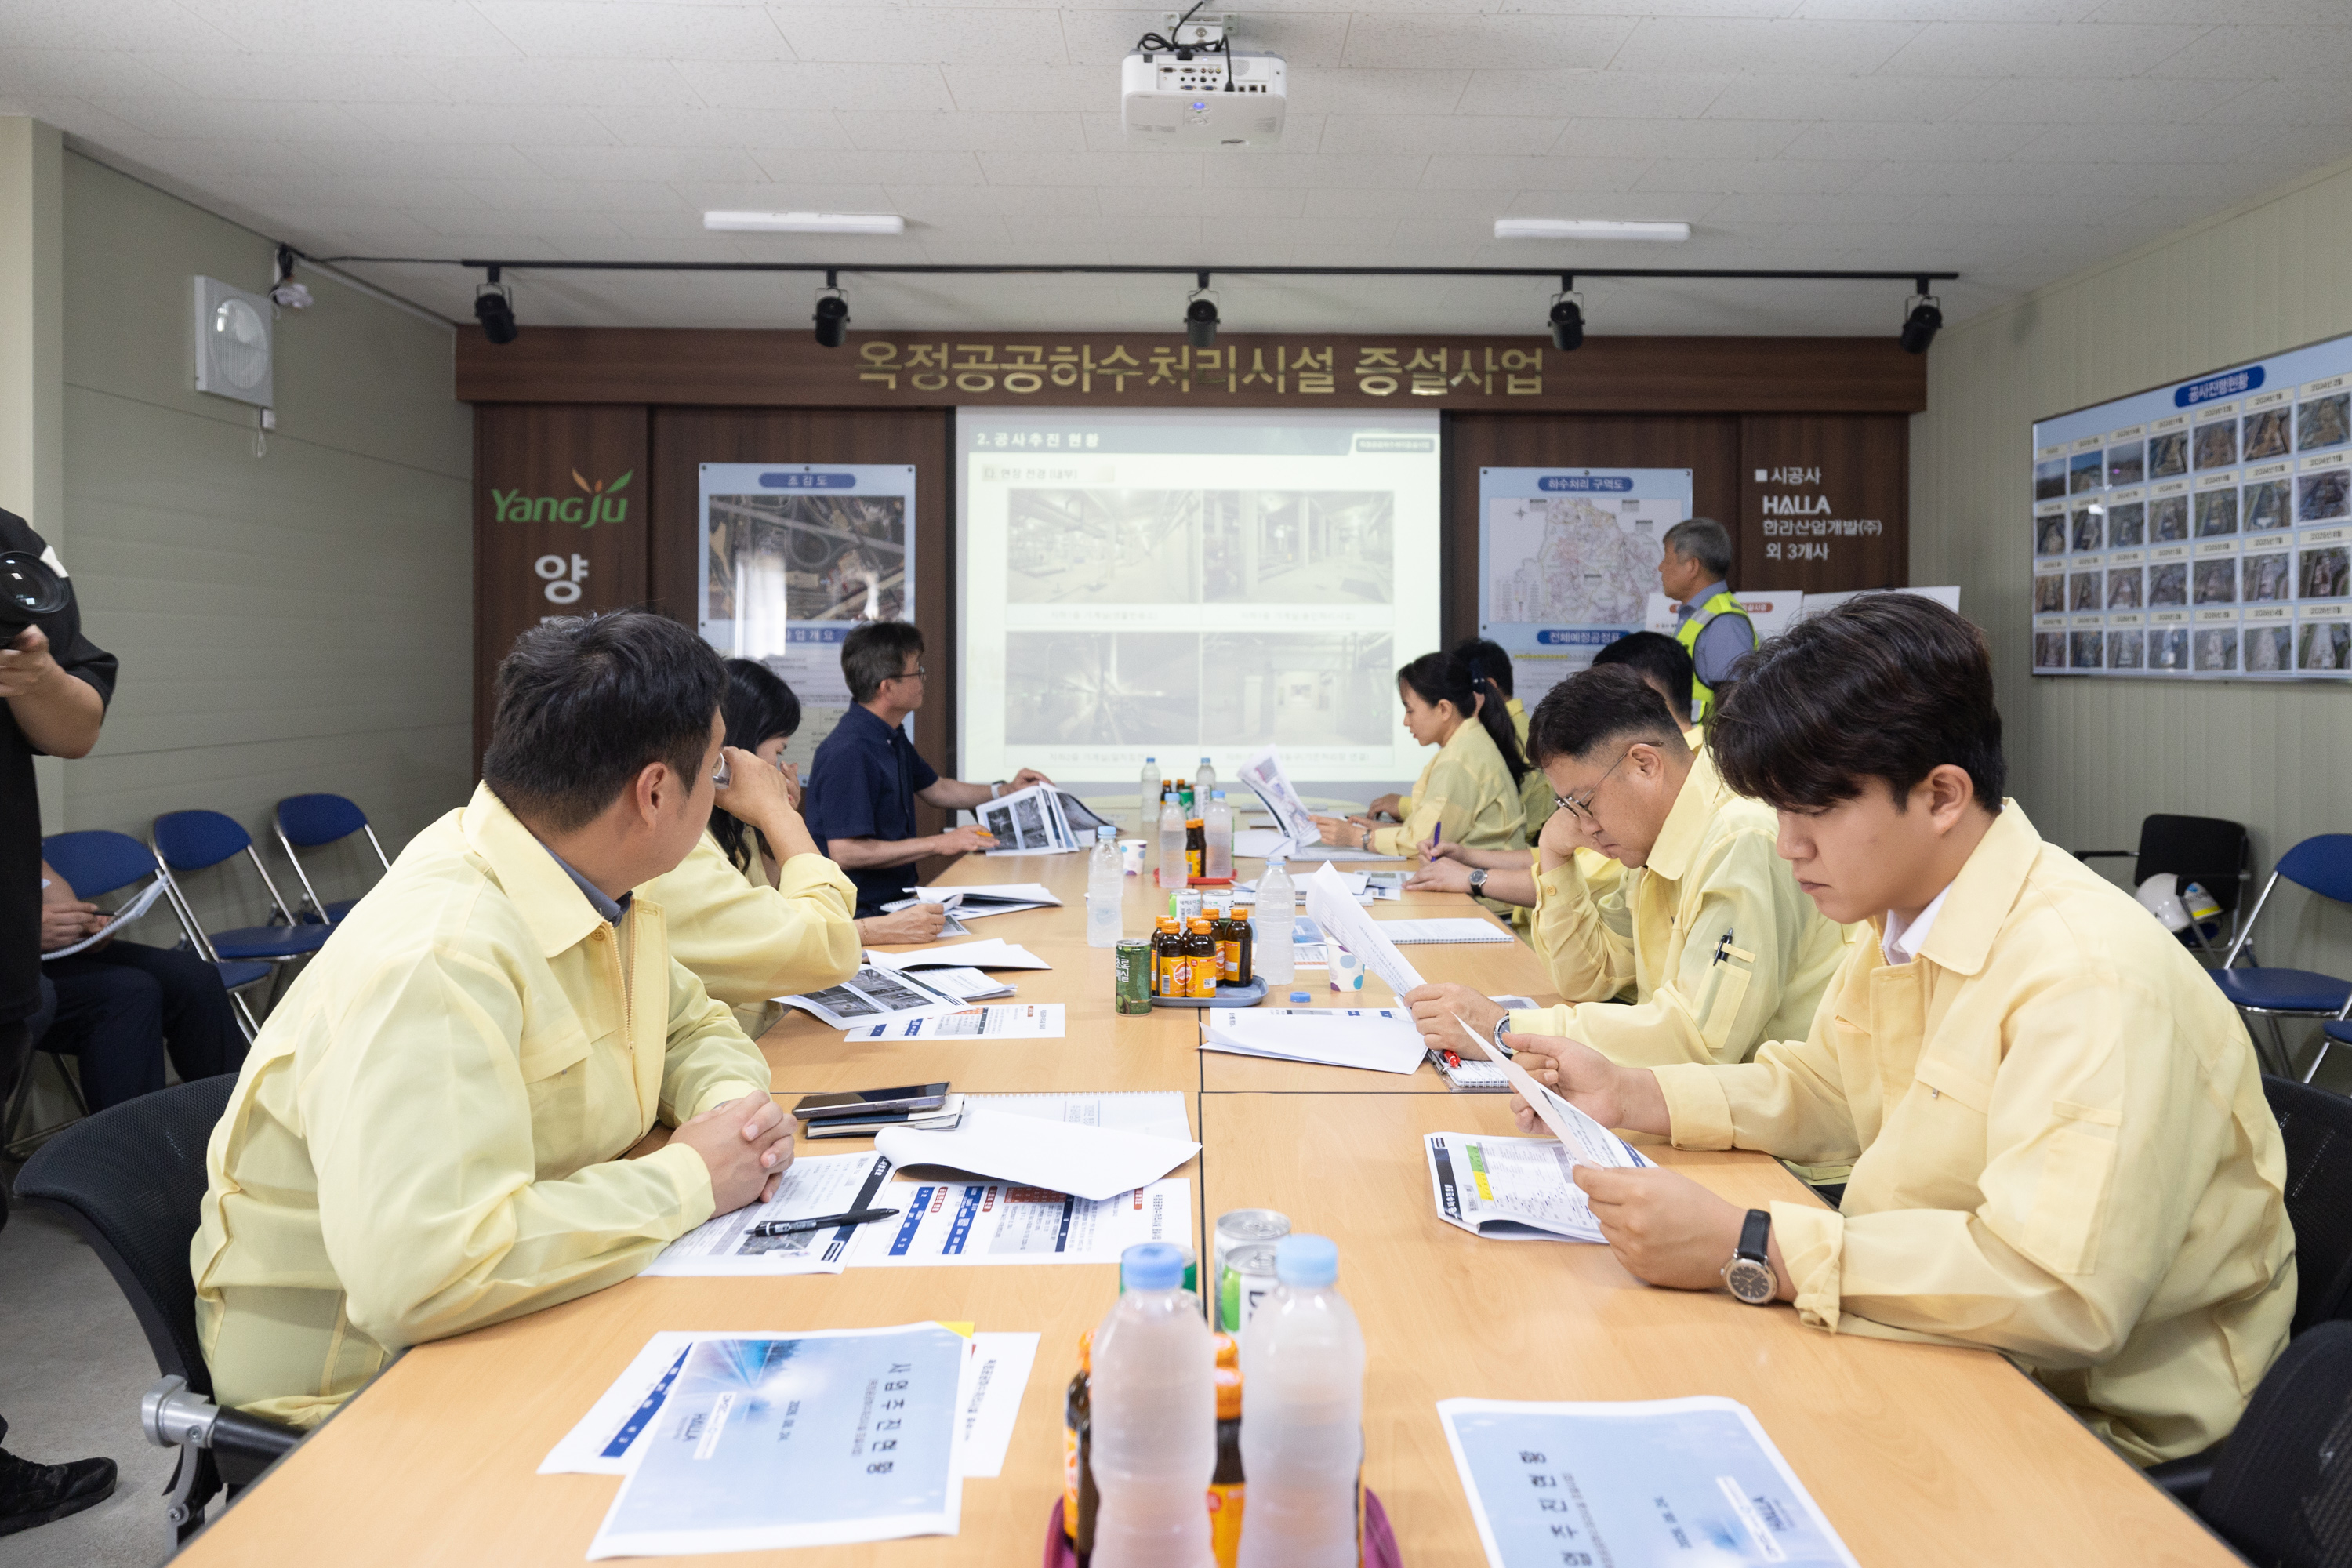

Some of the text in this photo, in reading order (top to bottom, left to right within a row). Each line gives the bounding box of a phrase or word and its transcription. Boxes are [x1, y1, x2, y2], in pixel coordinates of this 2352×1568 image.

[855, 340, 1545, 397] 옥정공공하수처리시설 증설사업
[977, 432, 1100, 448] 2. 공사추진 현황
[1770, 466, 1821, 485] 시공사
[1548, 480, 1590, 490] 하수처리
[1762, 495, 1831, 515] HALLA
[1762, 519, 1882, 537] 한라산업개발(주)
[1766, 543, 1829, 561] 외 3개사
[535, 553, 589, 604] 양
